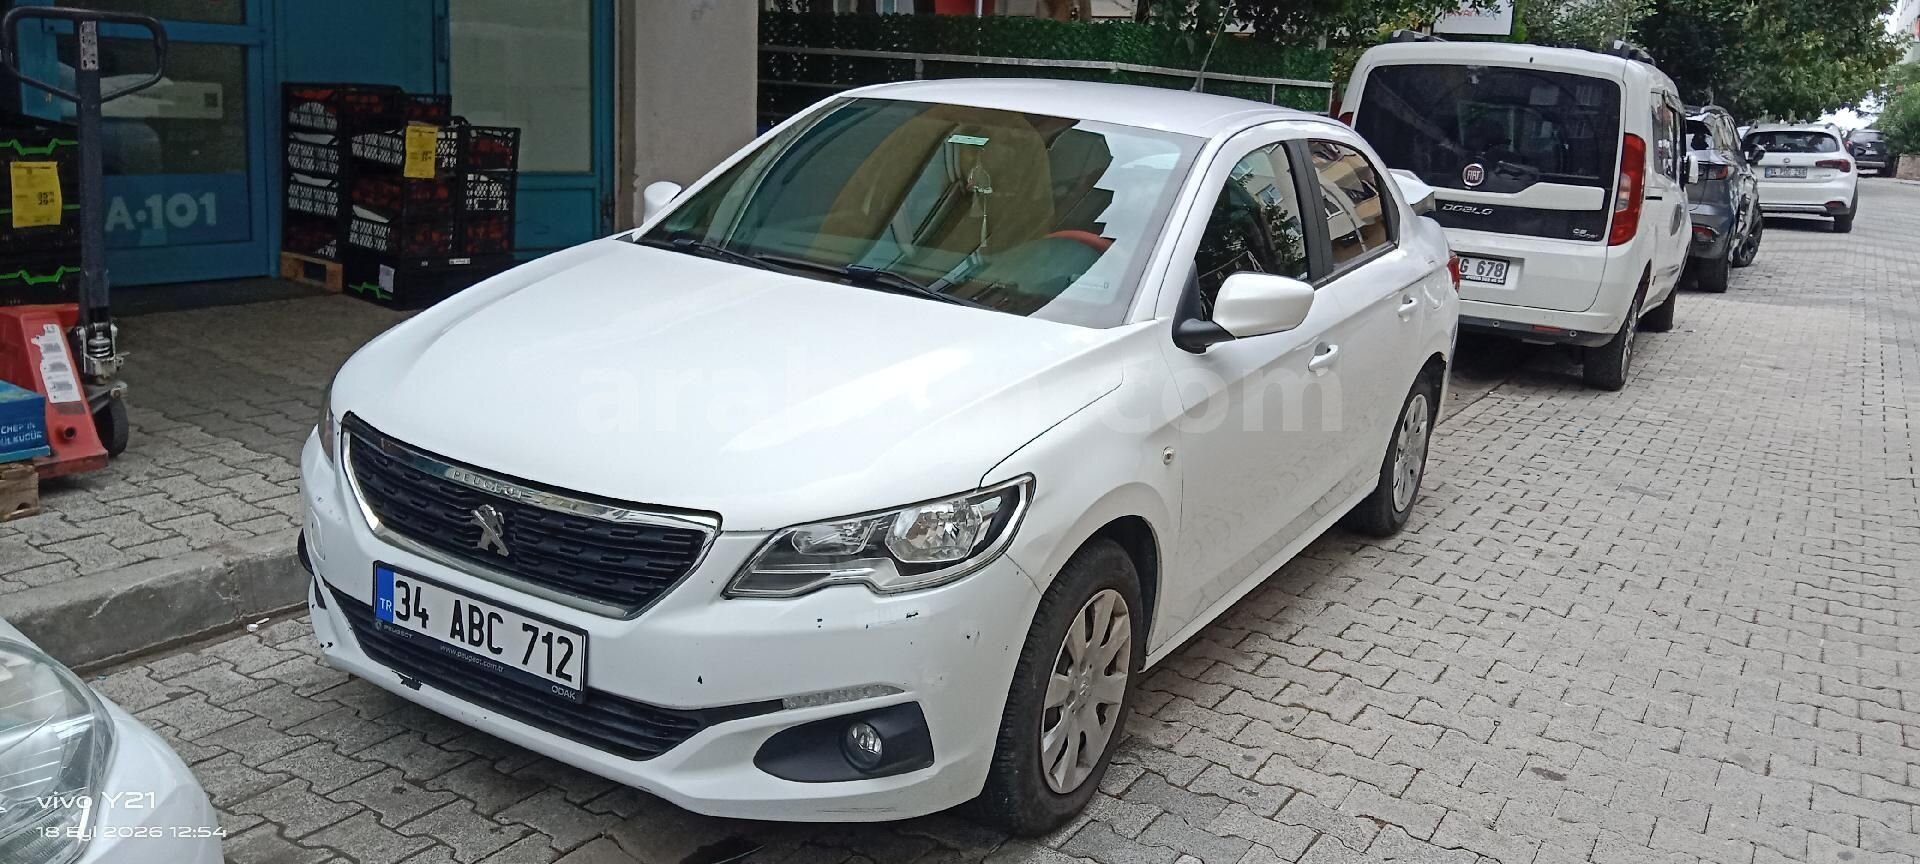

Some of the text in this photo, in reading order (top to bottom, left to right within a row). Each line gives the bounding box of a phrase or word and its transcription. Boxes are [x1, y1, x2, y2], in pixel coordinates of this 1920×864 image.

[1466, 170, 1481, 181] FIAT
[1442, 203, 1493, 215] DOBLO
[1476, 260, 1505, 278] 678
[452, 470, 525, 499] PEUGEOT
[380, 597, 392, 613] TR
[383, 623, 413, 639] PEUGEOT
[395, 580, 575, 683] 34 ABC 712
[551, 684, 576, 701] ODAK
